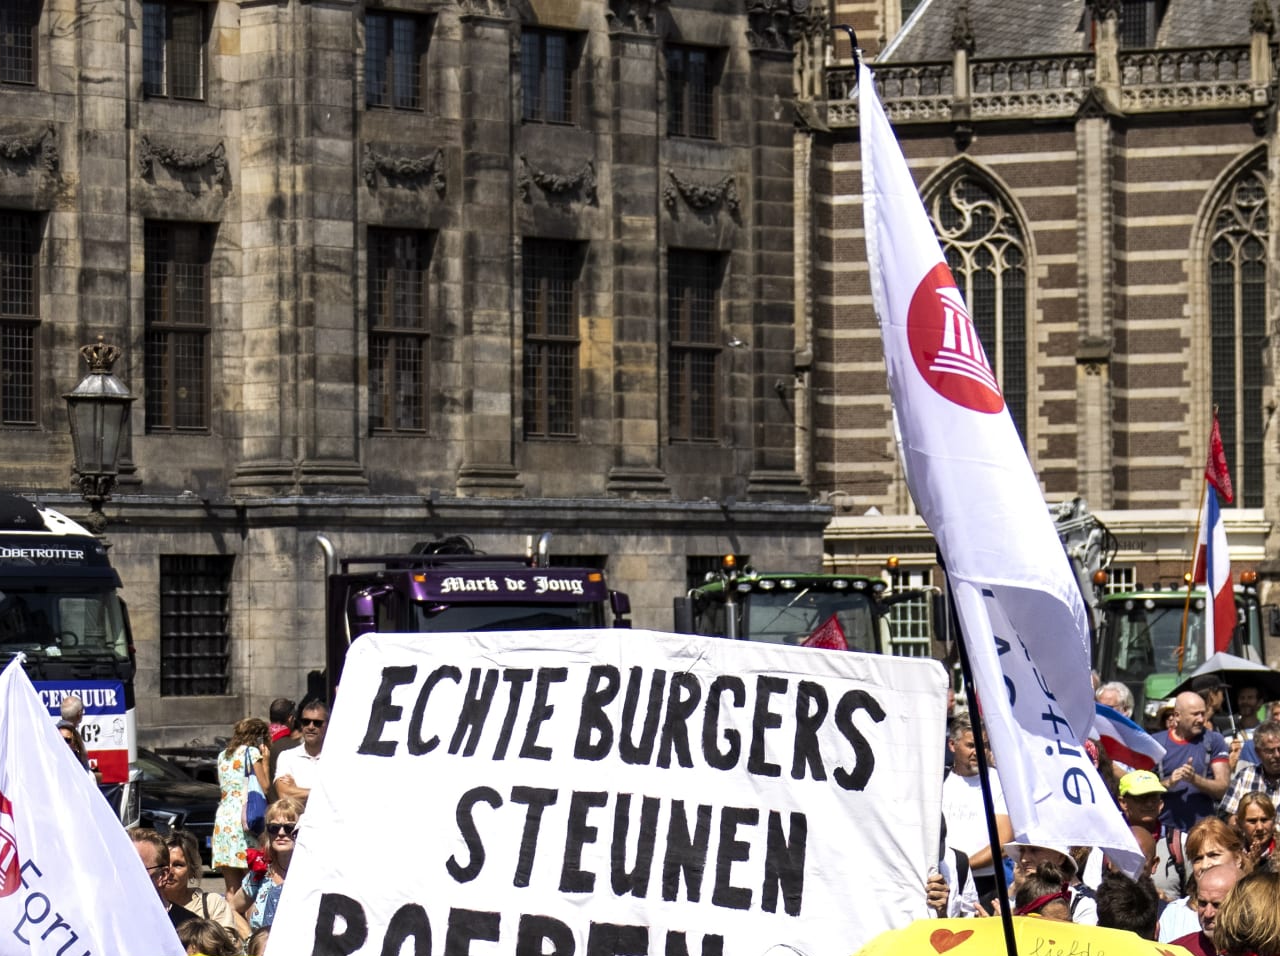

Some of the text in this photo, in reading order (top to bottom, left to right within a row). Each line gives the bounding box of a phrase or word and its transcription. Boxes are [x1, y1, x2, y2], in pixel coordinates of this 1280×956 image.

[440, 576, 584, 595] Mark de Jong
[357, 664, 569, 761] ECHTE
[573, 664, 887, 792] BURGERS
[445, 786, 808, 918] STEUNEN
